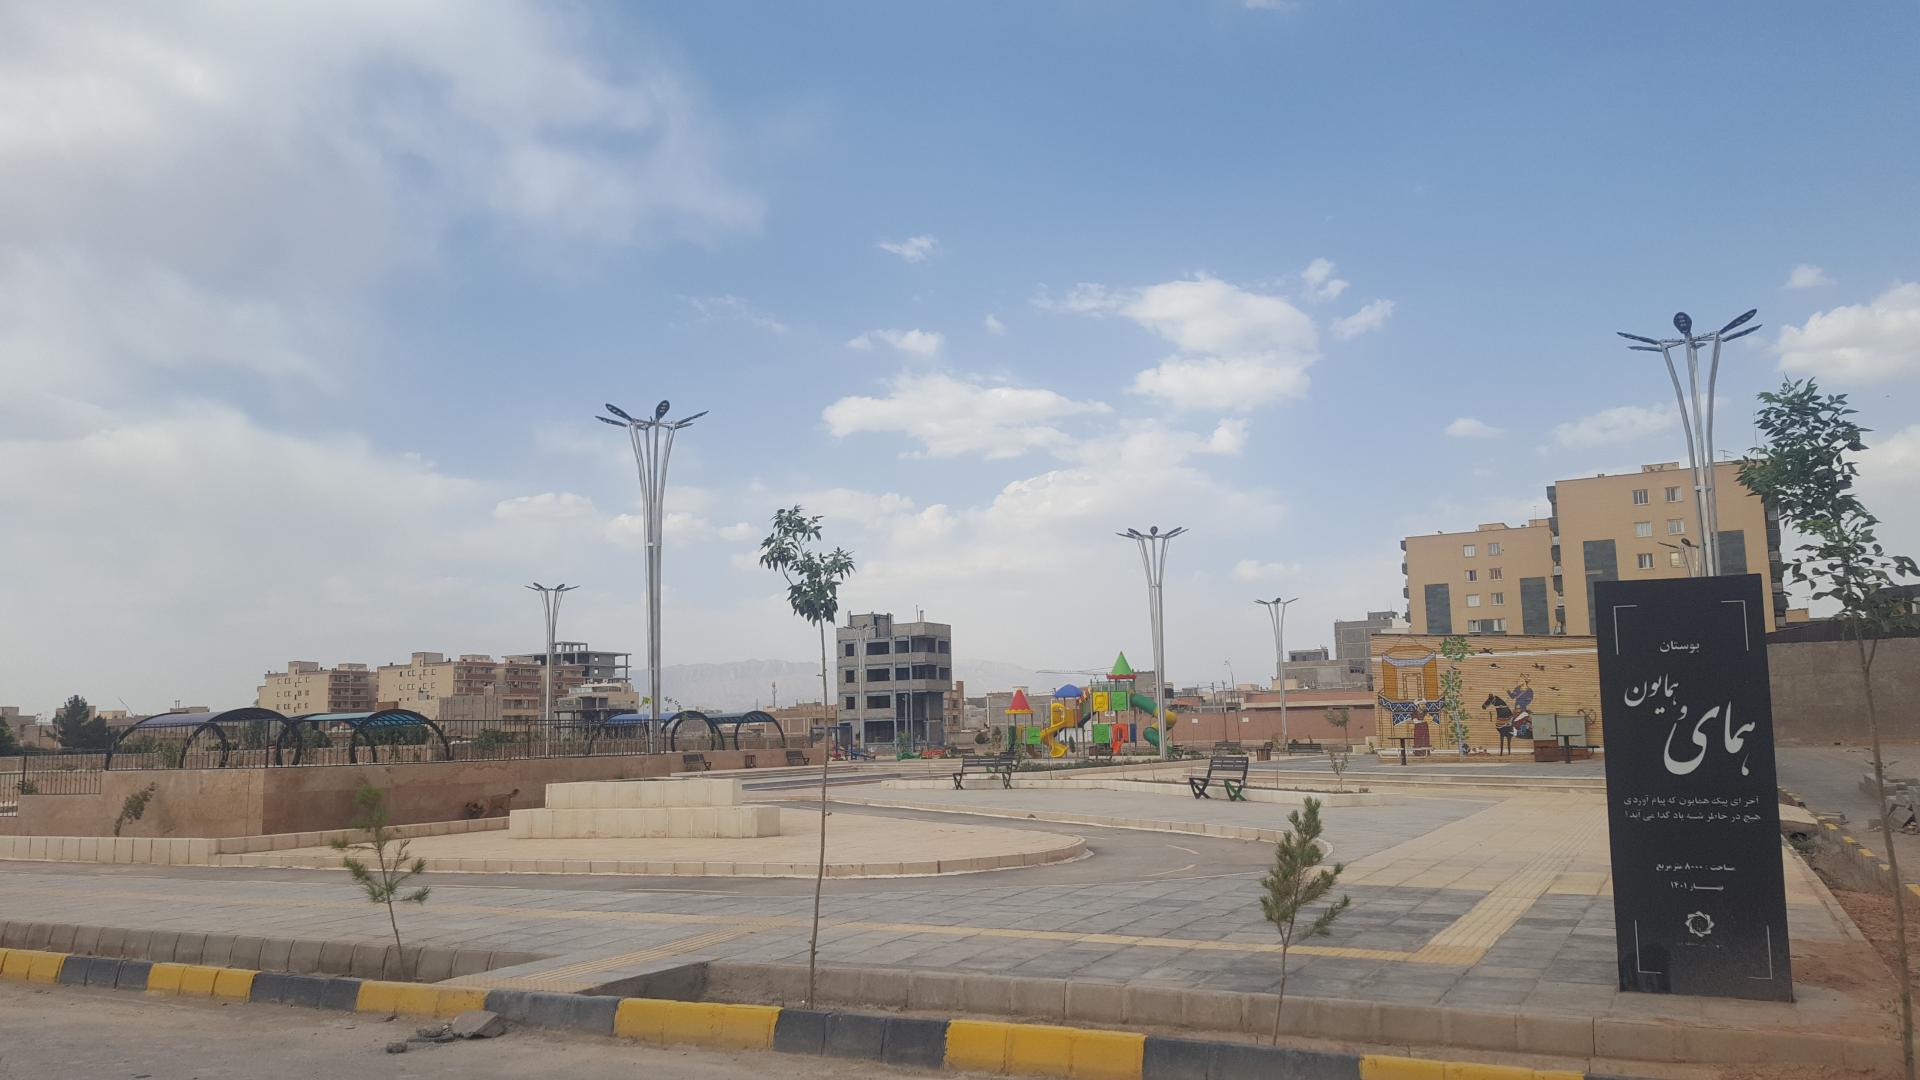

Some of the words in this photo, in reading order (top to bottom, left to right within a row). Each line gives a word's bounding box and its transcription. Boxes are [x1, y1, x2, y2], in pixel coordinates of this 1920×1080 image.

[1659, 640, 1700, 653] بوستان
[1623, 672, 1680, 715] همایون
[1677, 704, 1688, 721] و
[1663, 700, 1756, 776] همای
[1731, 814, 1741, 823] در
